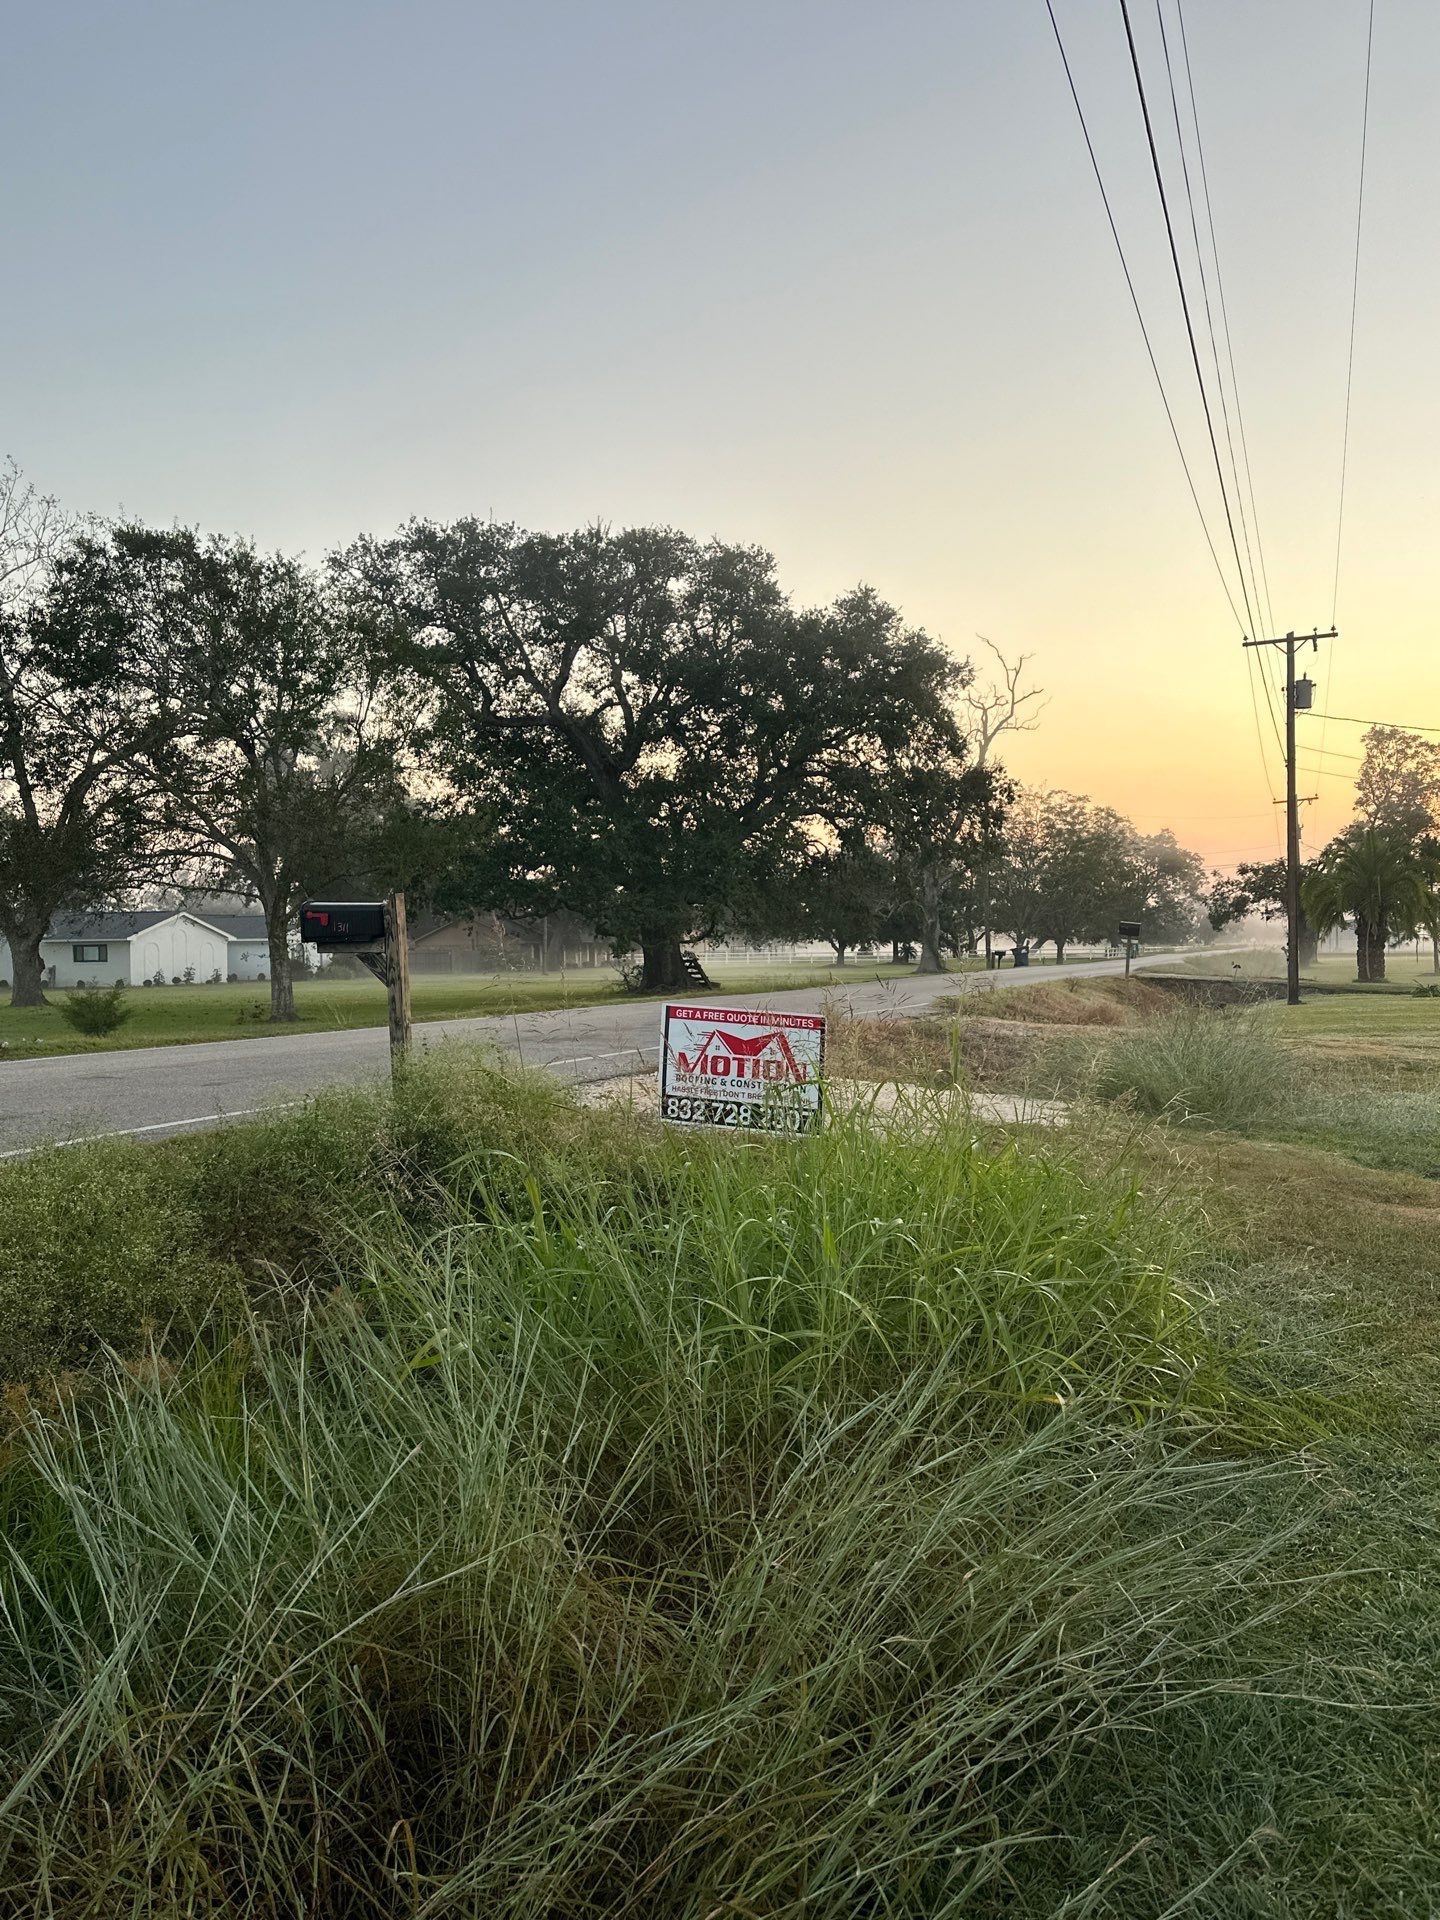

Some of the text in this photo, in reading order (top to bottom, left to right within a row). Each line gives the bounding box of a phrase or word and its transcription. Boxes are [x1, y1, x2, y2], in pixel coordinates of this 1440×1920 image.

[675, 1008, 814, 1028] GET A FREE QUOTE IN MINUTES
[678, 1046, 807, 1083] MOTION
[720, 1078, 728, 1087] &
[723, 1090, 745, 1099] DON'T
